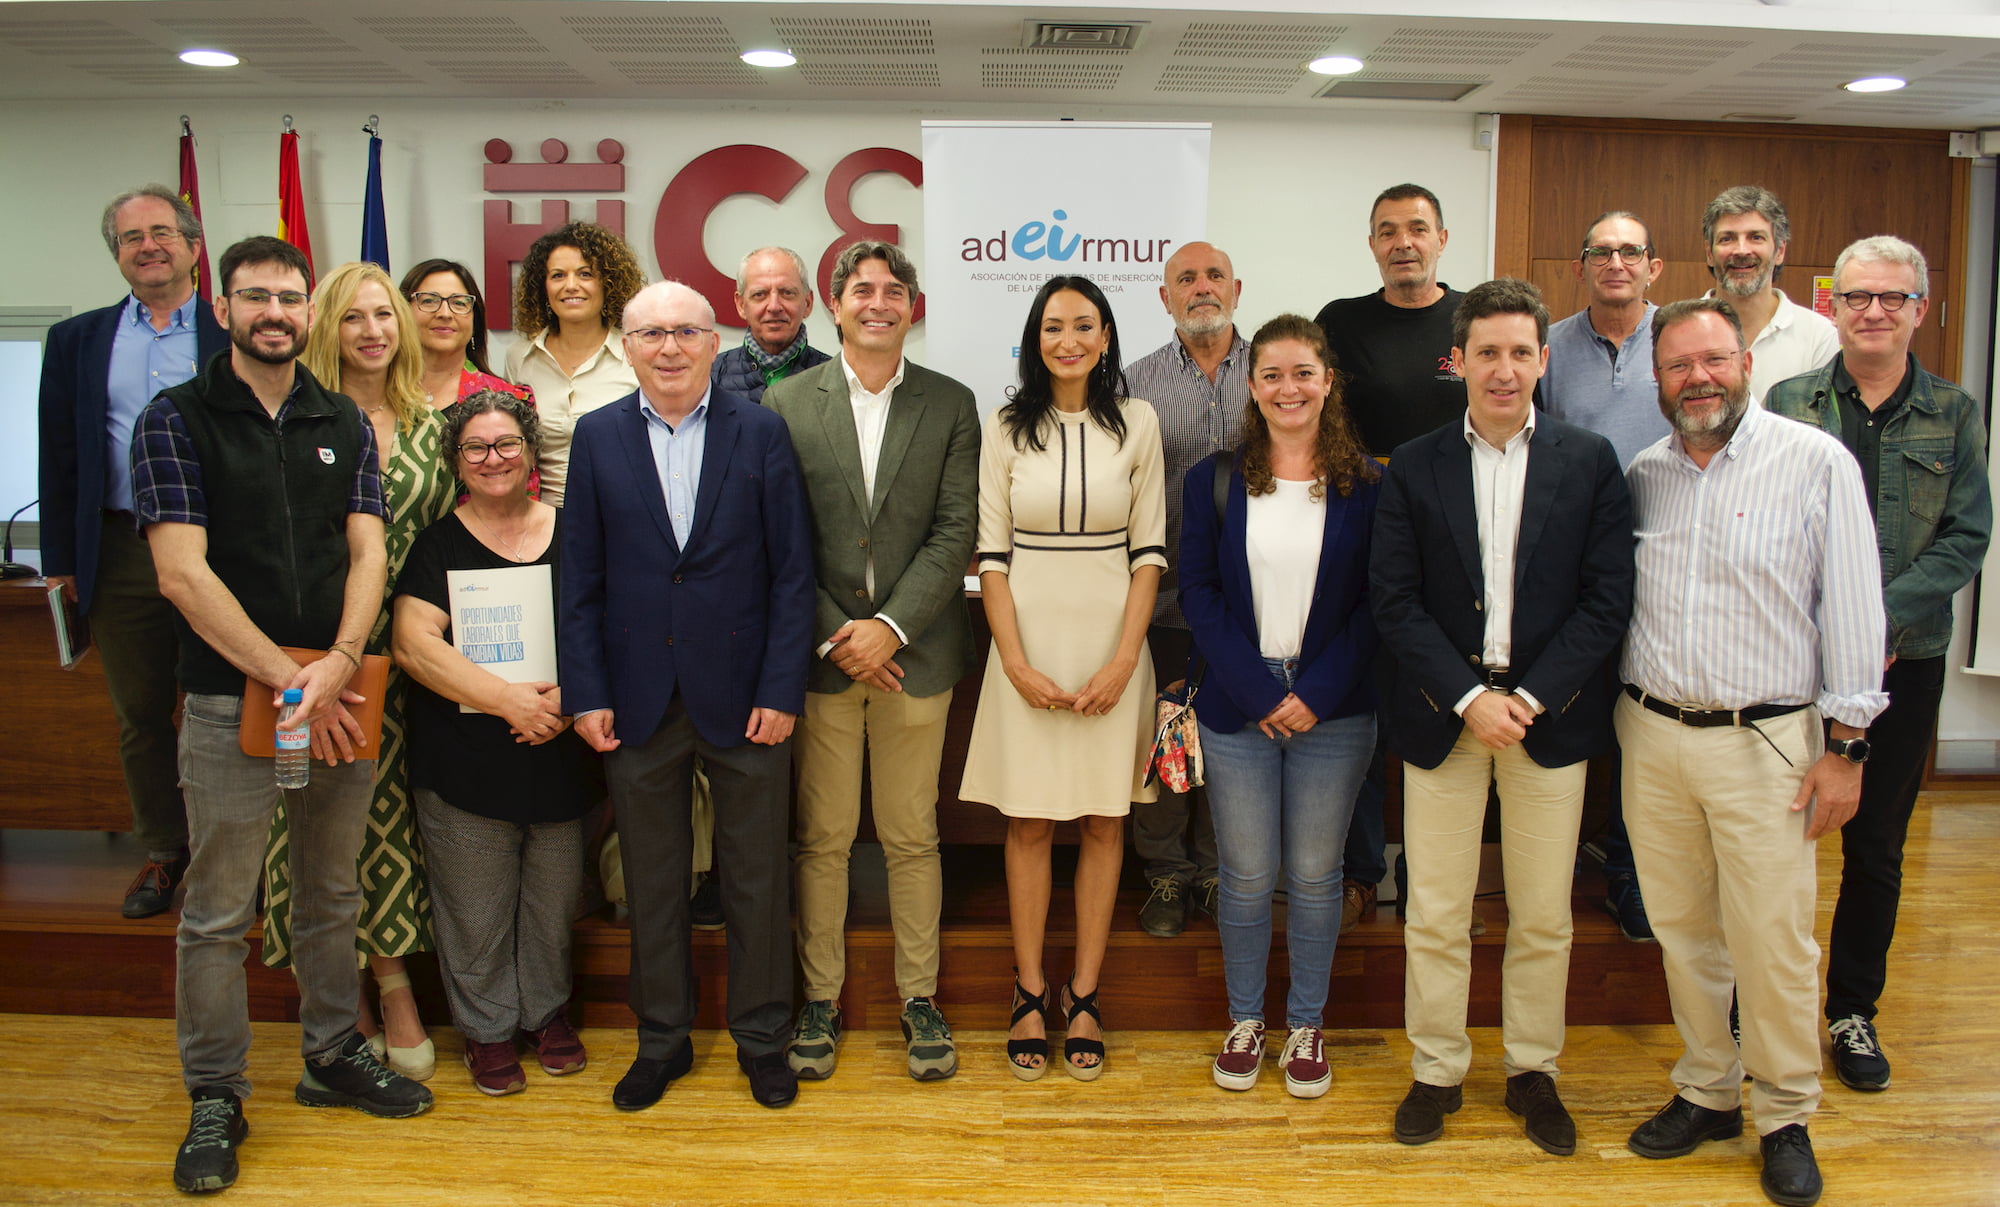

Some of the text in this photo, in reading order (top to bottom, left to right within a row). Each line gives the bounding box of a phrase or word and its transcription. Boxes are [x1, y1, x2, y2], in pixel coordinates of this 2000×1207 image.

[961, 209, 1171, 262] adeirmur
[971, 272, 1027, 281] ASOCIACIÓN
[1030, 273, 1042, 281] DE
[1113, 273, 1162, 281] INSERCIÓN
[461, 605, 522, 624] OPORTUNIDADES
[463, 624, 520, 643] LABORALES QUE
[500, 643, 522, 660] VIDAS
[279, 733, 306, 741] BEZOYA
